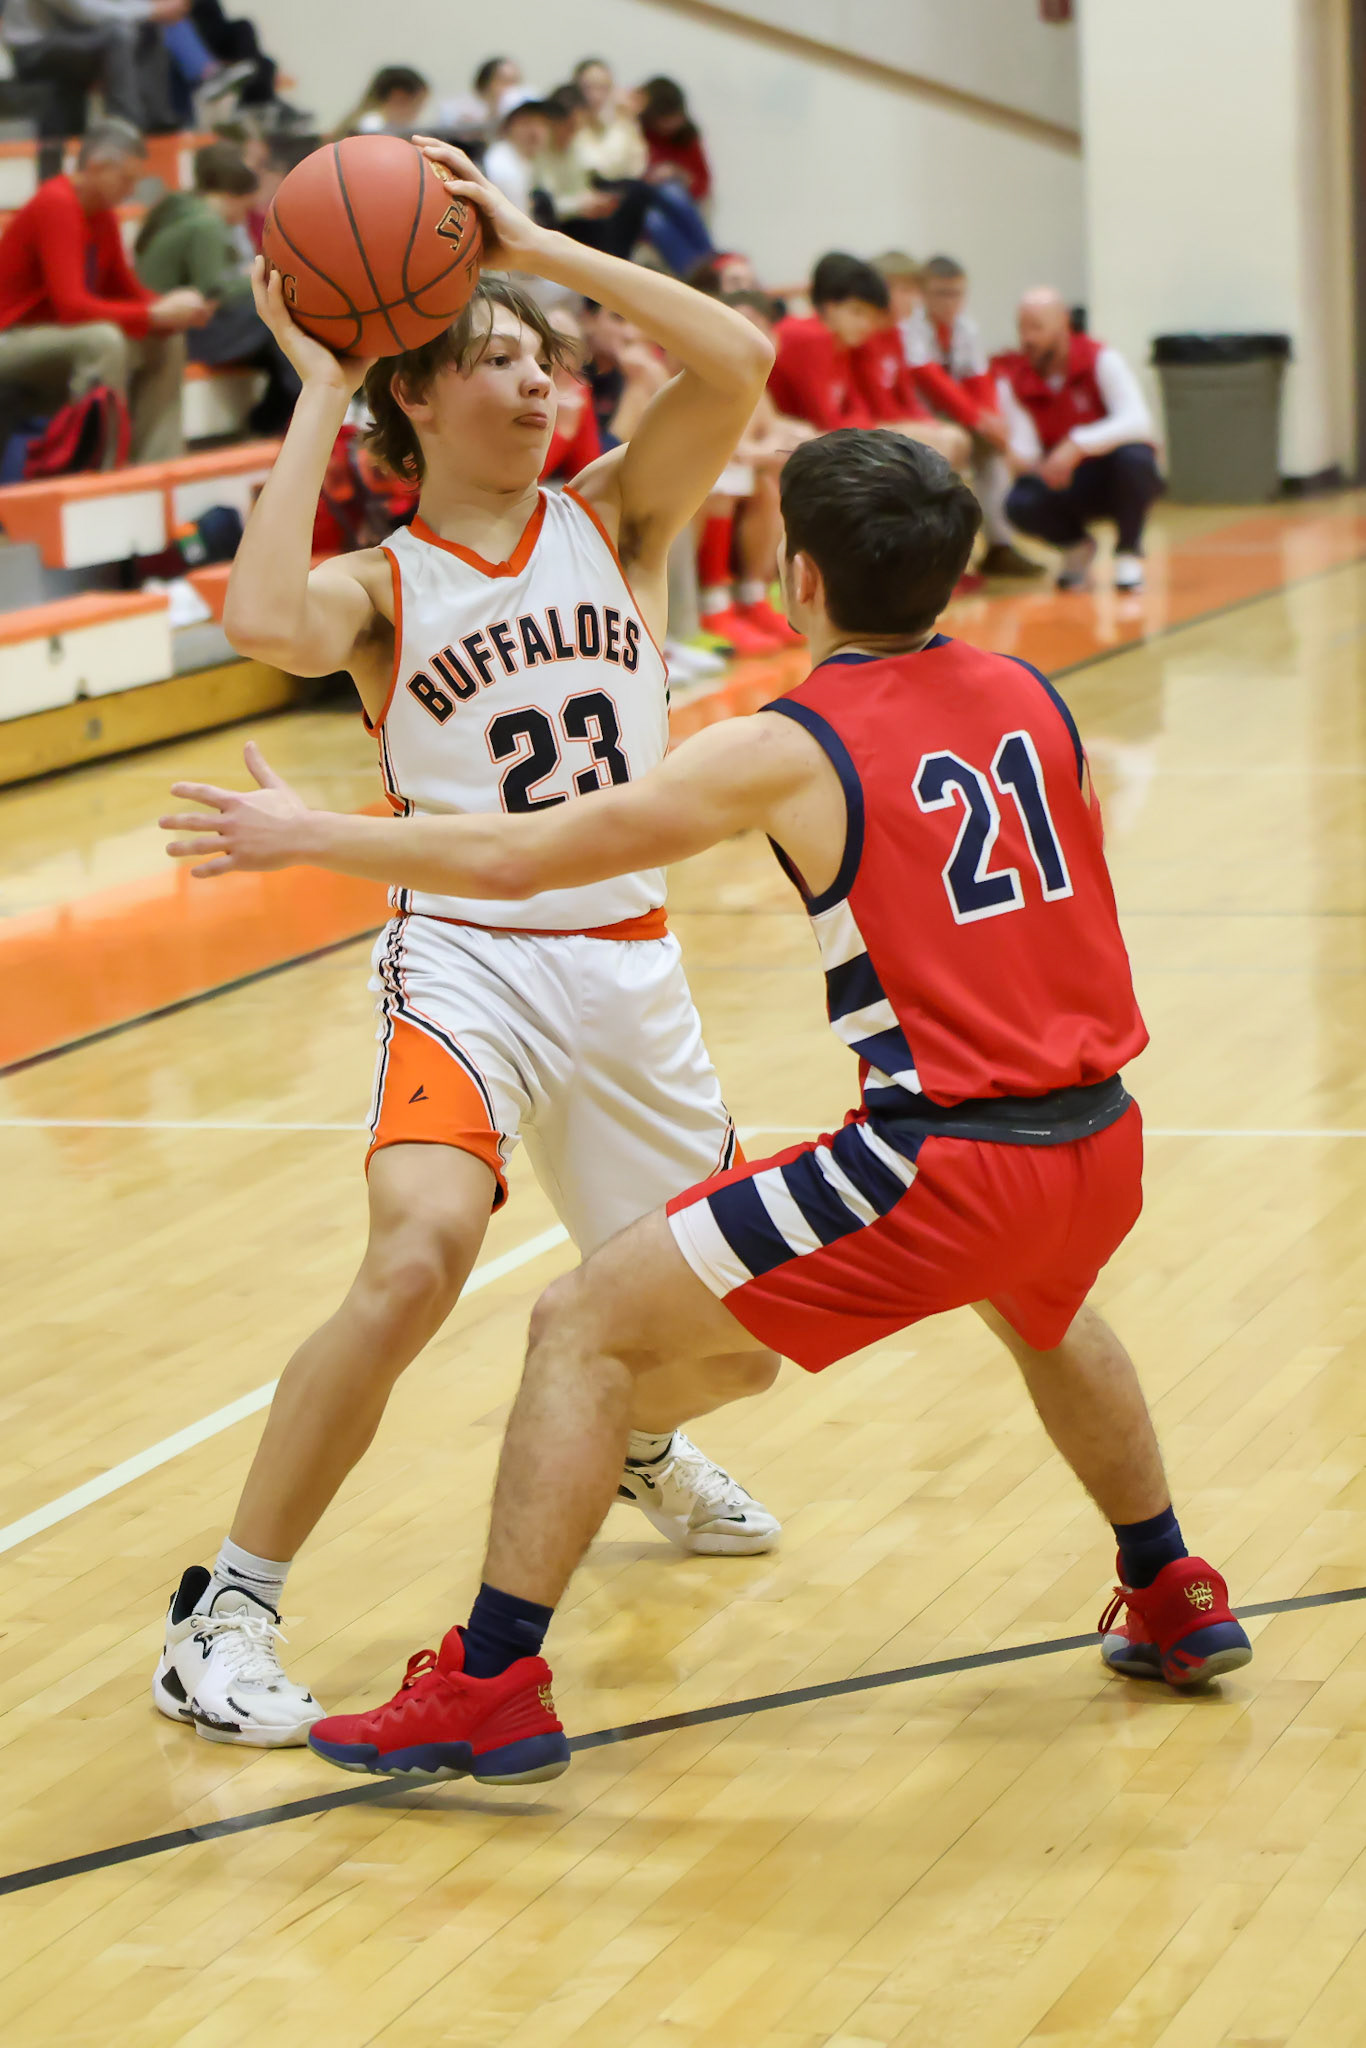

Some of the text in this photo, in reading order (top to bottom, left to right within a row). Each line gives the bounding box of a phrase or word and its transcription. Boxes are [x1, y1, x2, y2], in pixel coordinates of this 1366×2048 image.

[406, 602, 641, 726] BUFFALOES
[484, 688, 631, 814] 23
[911, 729, 1074, 925] 21
